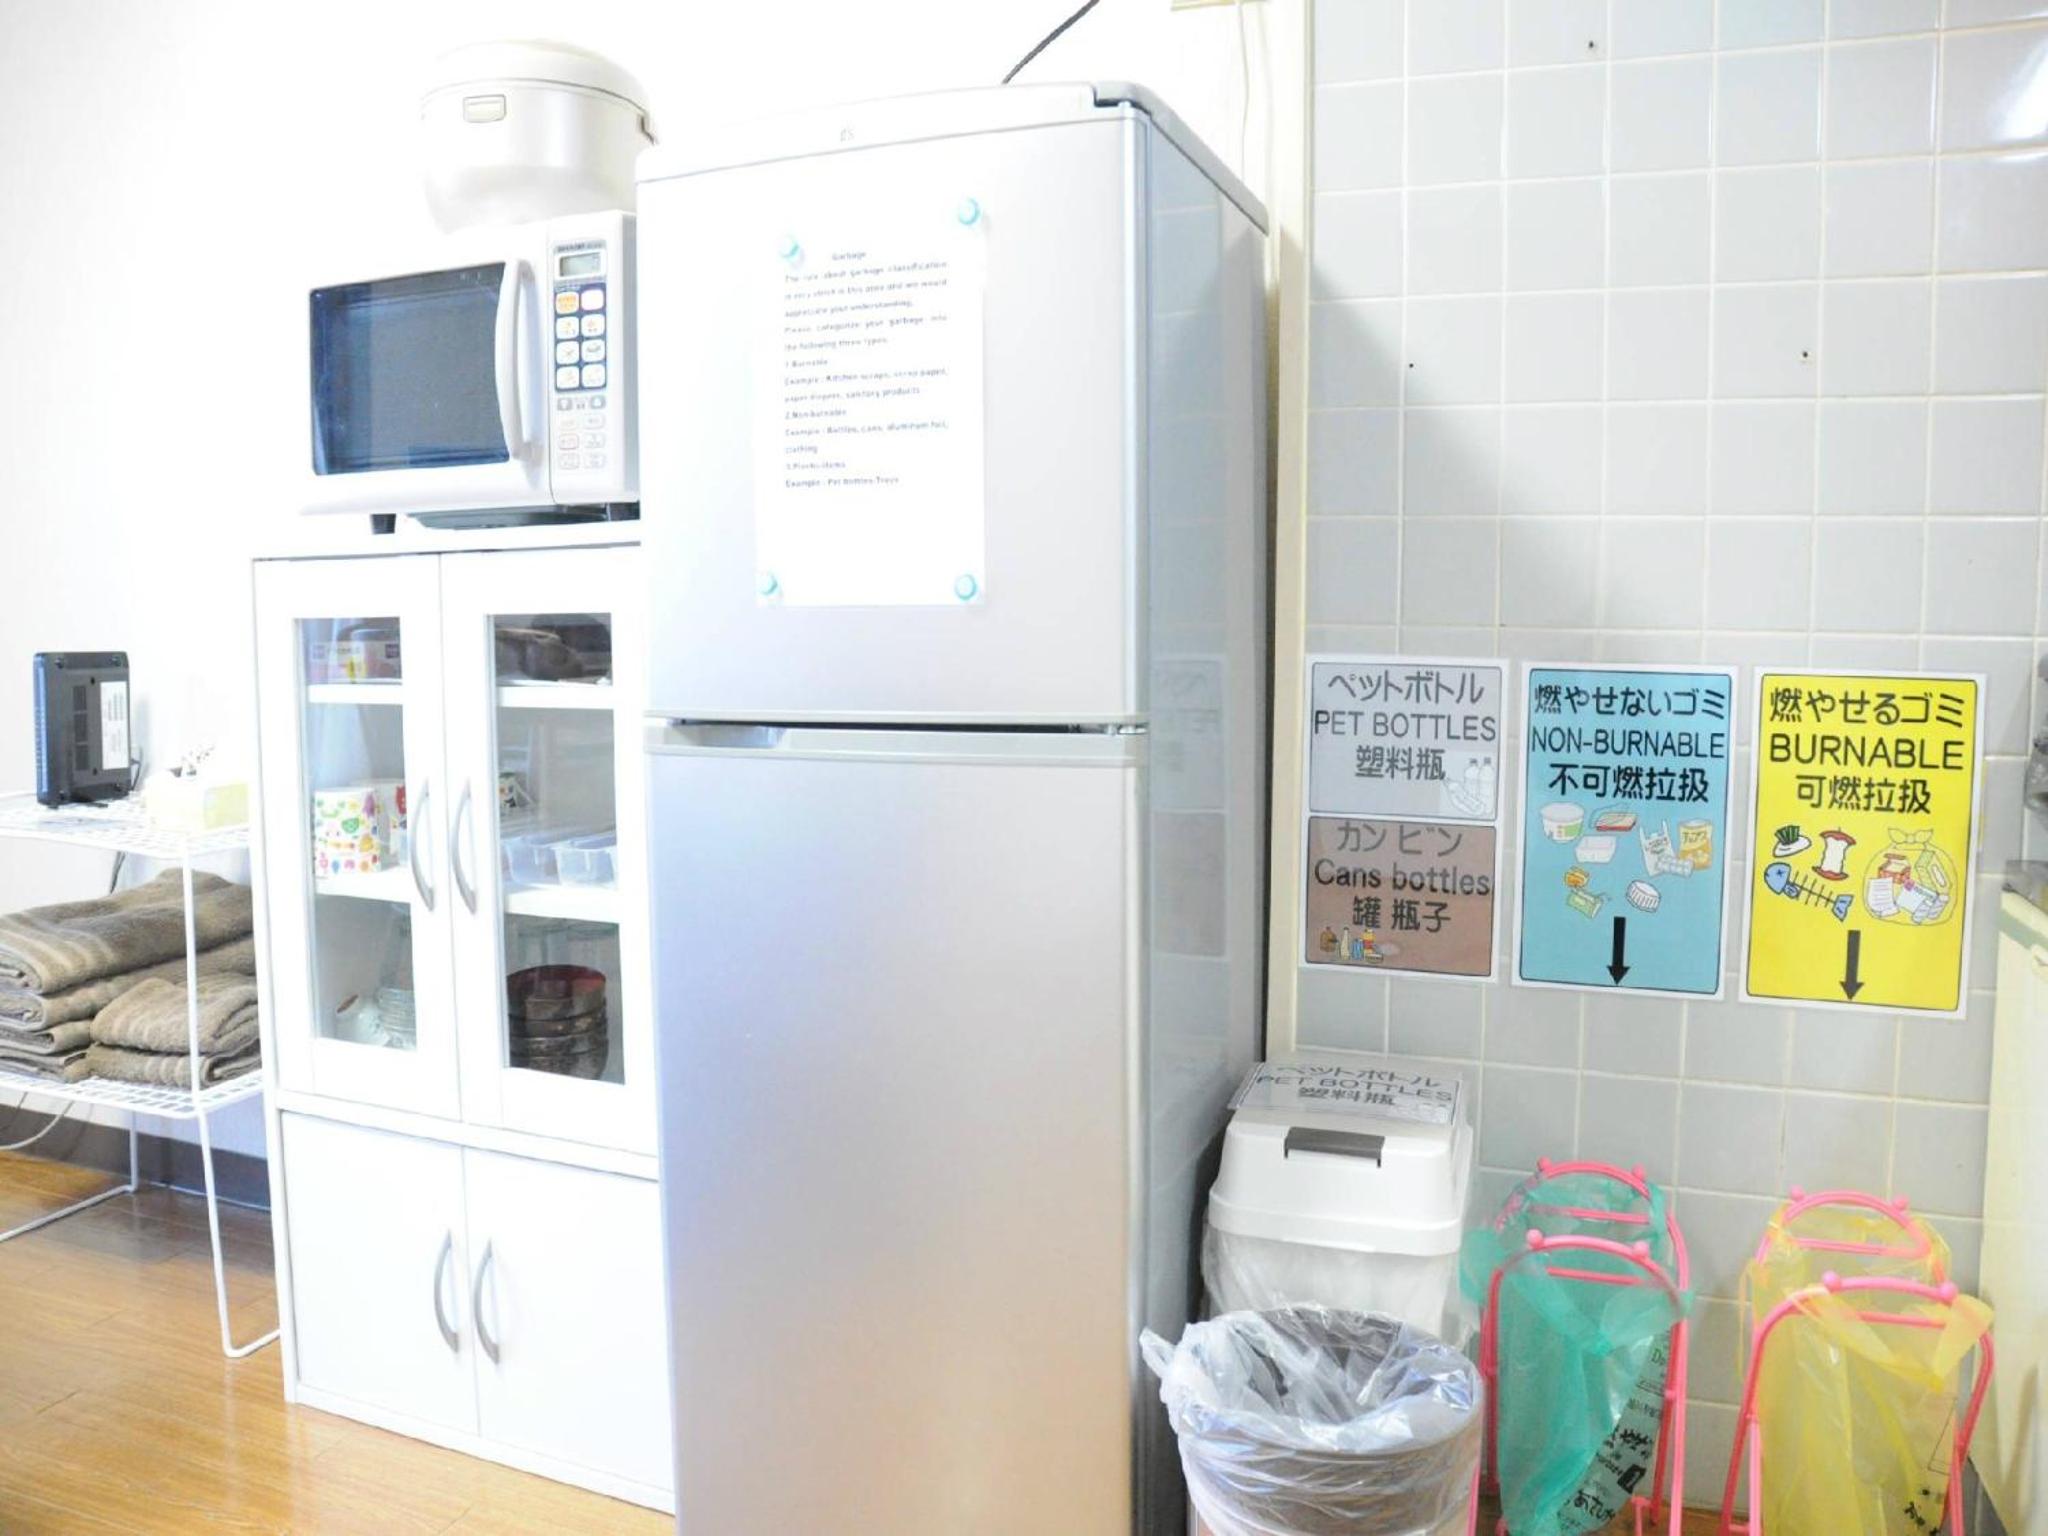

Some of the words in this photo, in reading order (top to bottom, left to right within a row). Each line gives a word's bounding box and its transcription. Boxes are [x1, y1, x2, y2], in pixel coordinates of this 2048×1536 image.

[1328, 669, 1484, 704] ペットボトル
[1534, 683, 1725, 720] 燃やせないゴミ
[1769, 687, 1964, 728] 燃やせるゴミ
[1314, 710, 1364, 735] PET
[1372, 712, 1496, 741] BOTTLES
[1532, 726, 1725, 759] NON-BURNABLE
[1355, 745, 1446, 781] 塑料瓶
[1769, 733, 1964, 770] BURNABLE
[1337, 821, 1387, 852] カン
[1400, 824, 1462, 856] ビン
[1314, 858, 1381, 888] Cans
[1393, 862, 1490, 896] bottles
[1391, 898, 1451, 933] 瓶子
[1256, 1076, 1311, 1086] PET
[1319, 1078, 1452, 1102] BOTTLES
